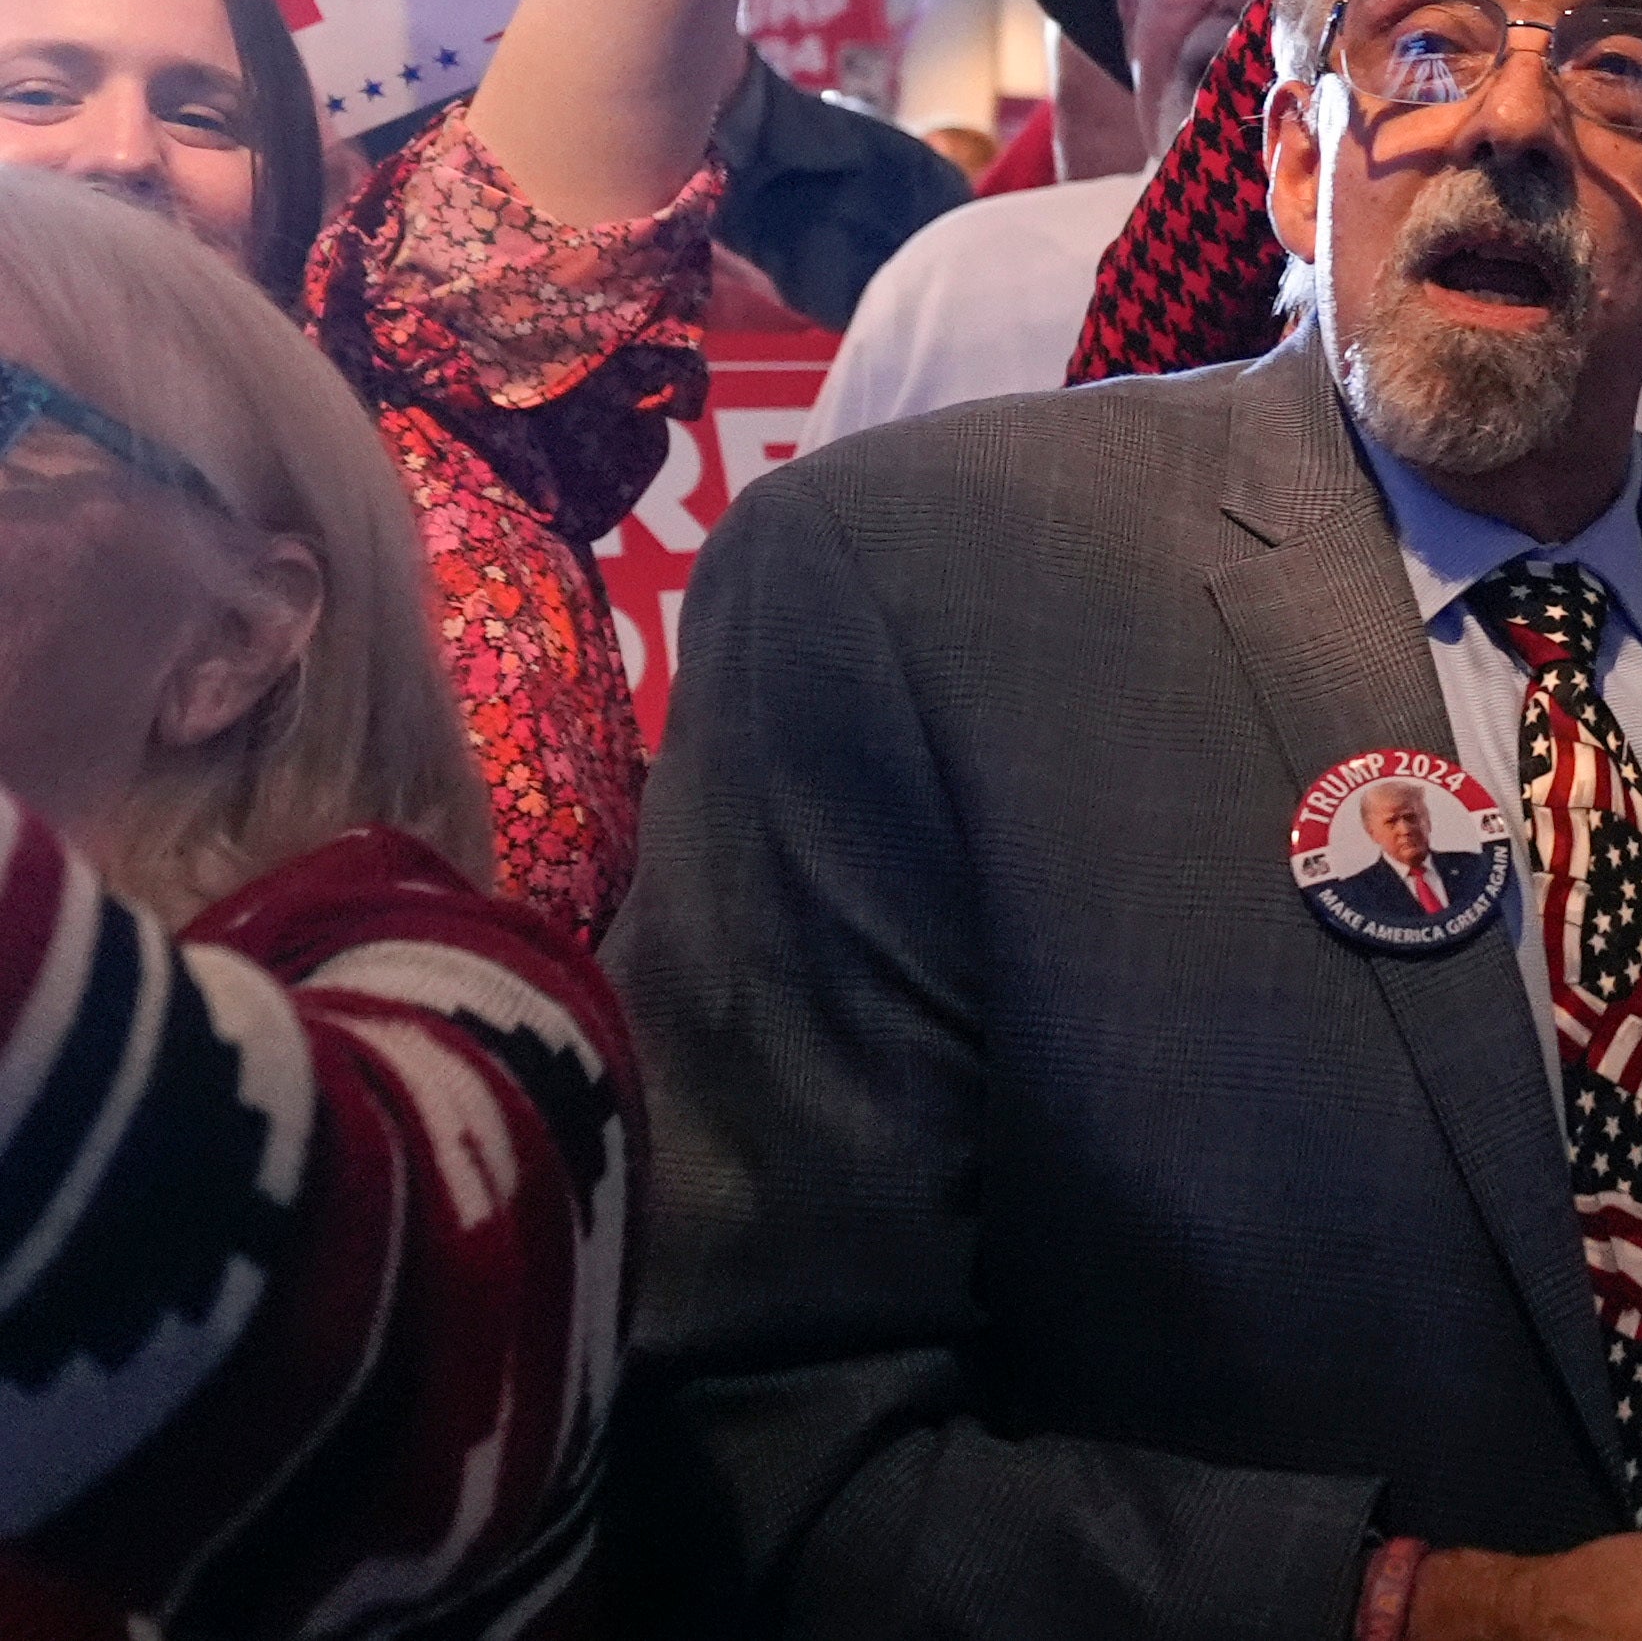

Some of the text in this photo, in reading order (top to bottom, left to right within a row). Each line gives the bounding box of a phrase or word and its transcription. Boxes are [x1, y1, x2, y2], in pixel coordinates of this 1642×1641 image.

[1300, 751, 1467, 825] TRUMP 2024
[1318, 845, 1510, 943] MAKE AMERICA GREAT AGAIN
